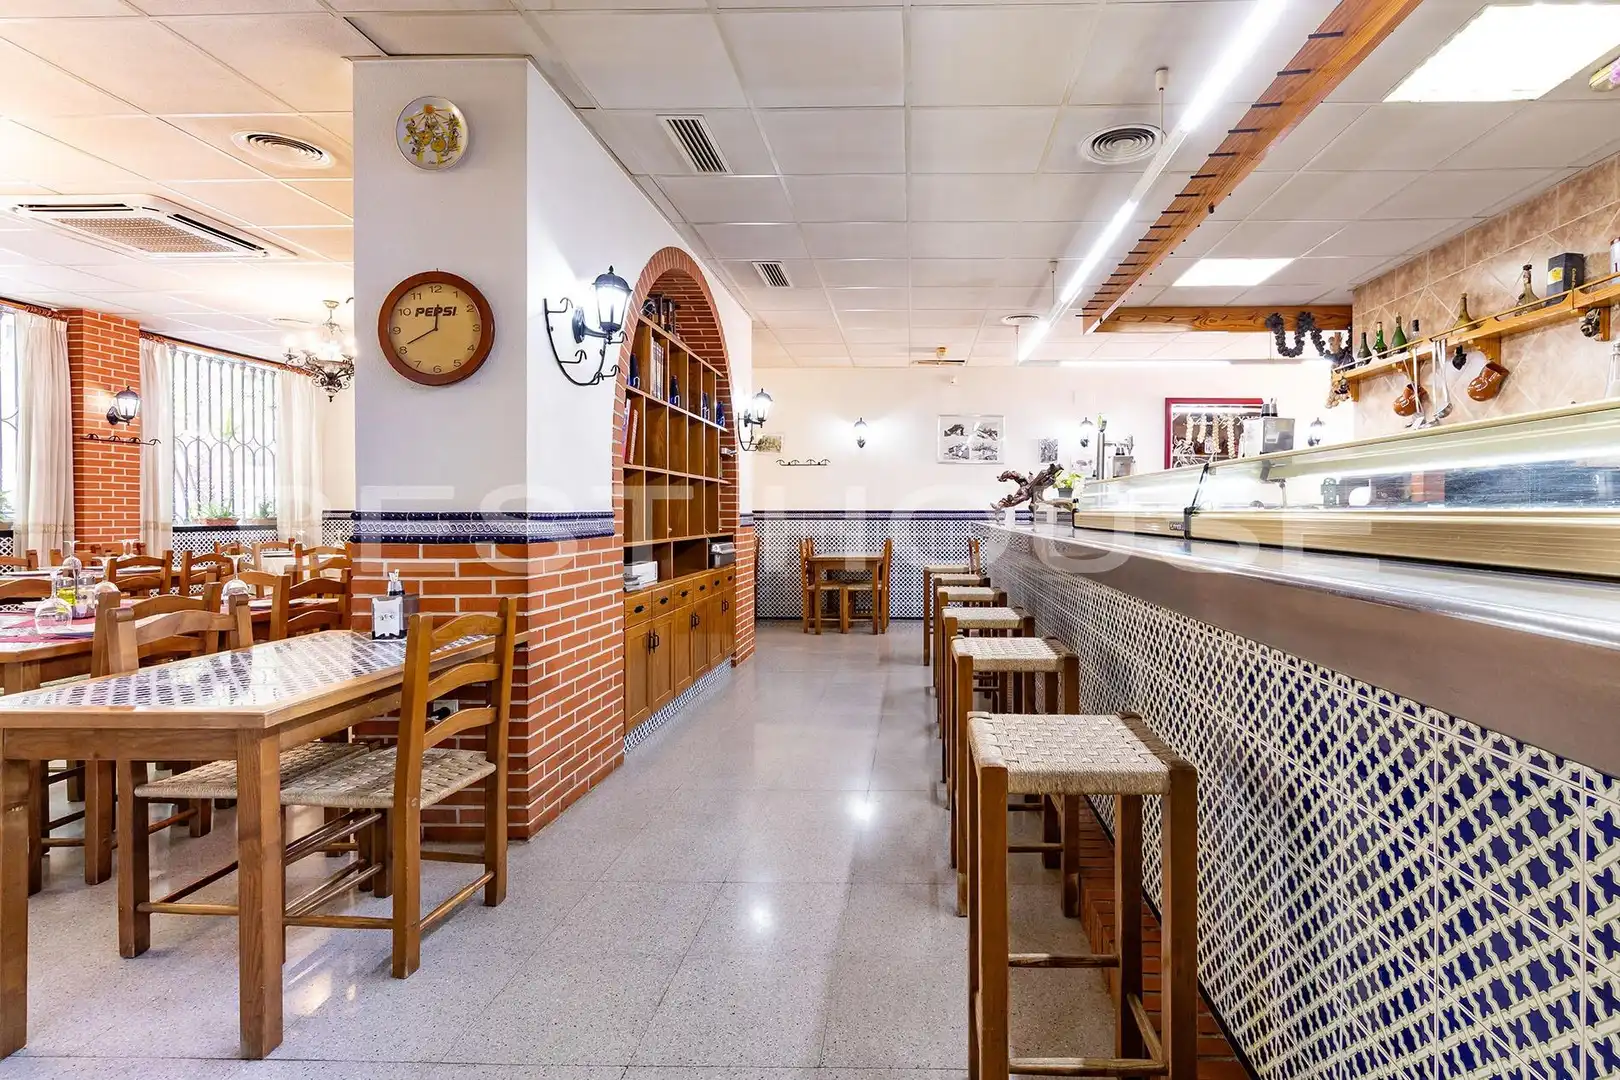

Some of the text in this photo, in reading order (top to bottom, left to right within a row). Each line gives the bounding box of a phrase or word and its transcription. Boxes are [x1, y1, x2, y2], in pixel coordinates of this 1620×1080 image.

[429, 285, 442, 293] 12
[398, 308, 411, 316] 10
[415, 306, 457, 317] PEPSI
[466, 304, 474, 313] 2
[392, 326, 401, 335] 9
[473, 324, 480, 332] 3
[399, 346, 408, 355] 8
[467, 344, 475, 352] 4
[414, 360, 422, 368] 7
[454, 359, 462, 367] 5
[433, 365, 442, 374] 6
